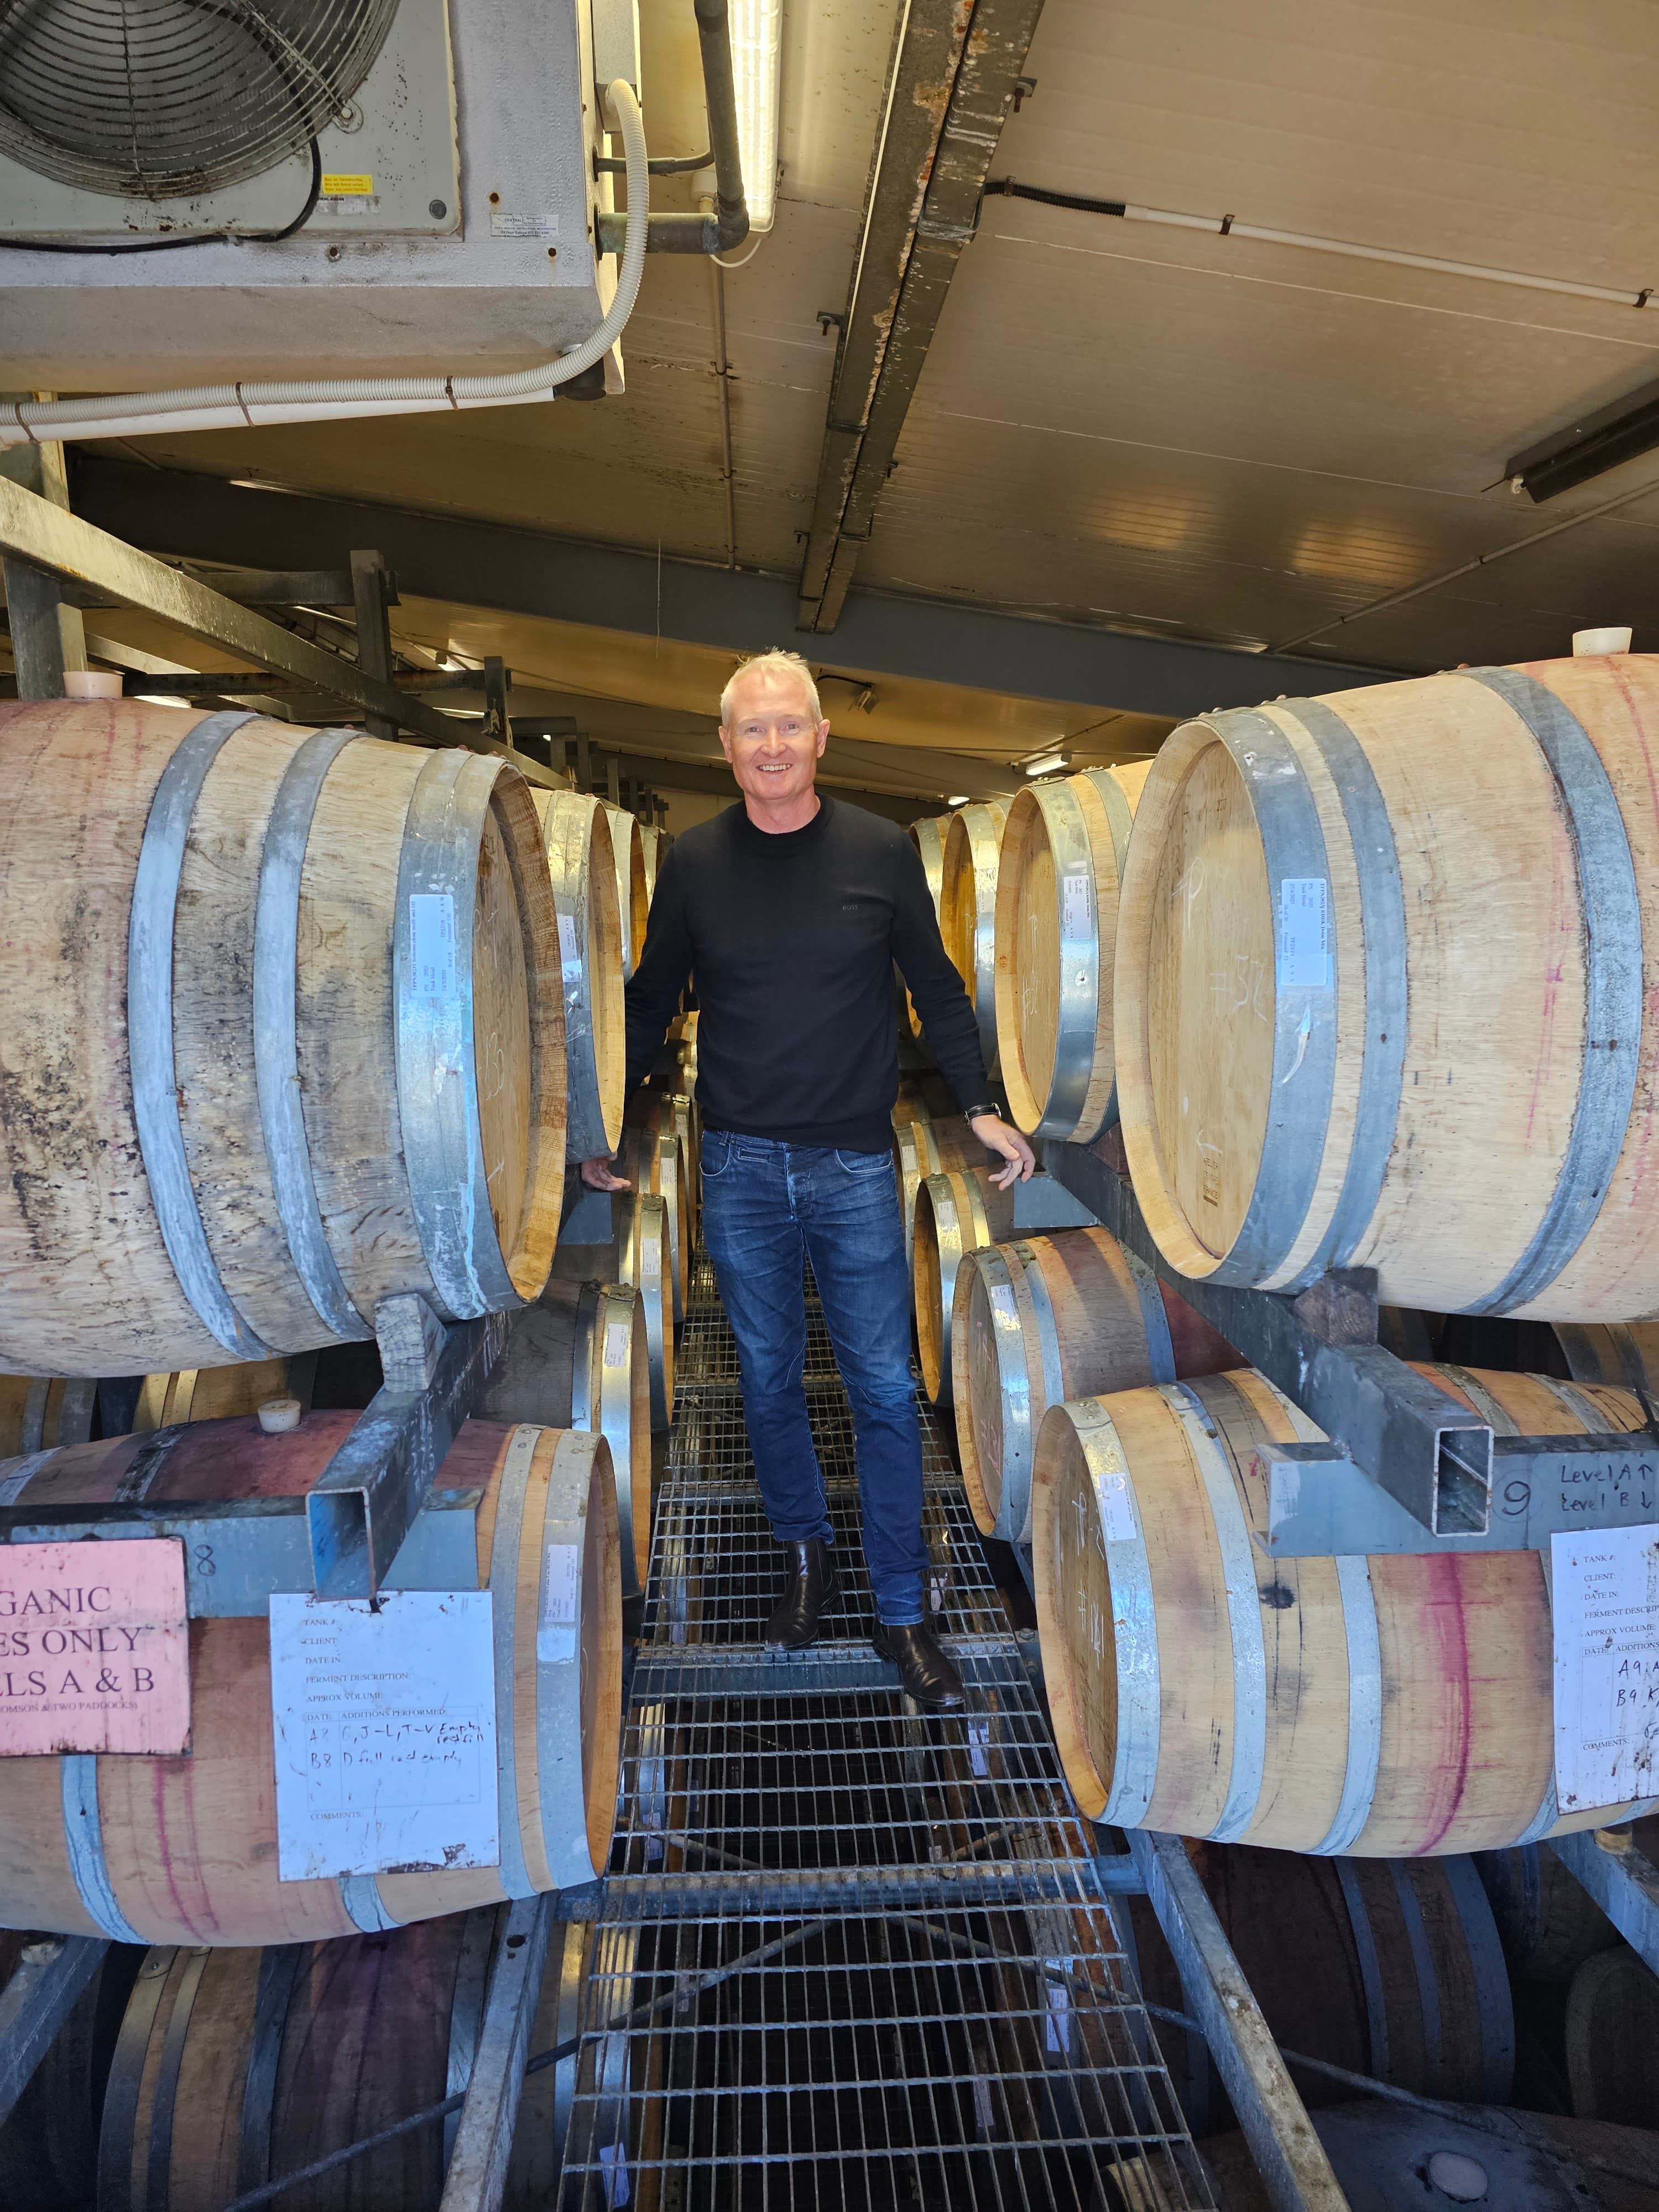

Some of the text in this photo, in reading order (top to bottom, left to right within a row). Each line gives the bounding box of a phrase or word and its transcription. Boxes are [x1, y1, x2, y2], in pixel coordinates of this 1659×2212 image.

[1561, 1464, 1631, 1483] Level A
[1503, 1481, 1531, 1515] 9
[1561, 1492, 1629, 1511] Level B
[194, 1545, 216, 1576] 8
[1584, 1573, 1616, 1582] CLIENT:
[1584, 1592, 1606, 1600] DATE
[1584, 1609, 1623, 1619] FERMENT
[1585, 1624, 1656, 1637] APPROX VOLUME:
[41, 1626, 142, 1655] ONLY
[59, 1670, 84, 1694] A
[96, 1668, 121, 1693] &
[133, 1667, 154, 1692] B
[305, 1673, 410, 1684] FERMENT DESCRIPTION:
[306, 1694, 342, 1702] APPROX
[341, 1710, 390, 1720] ADDITIONS
[1583, 1739, 1629, 1751] COMMENTS:
